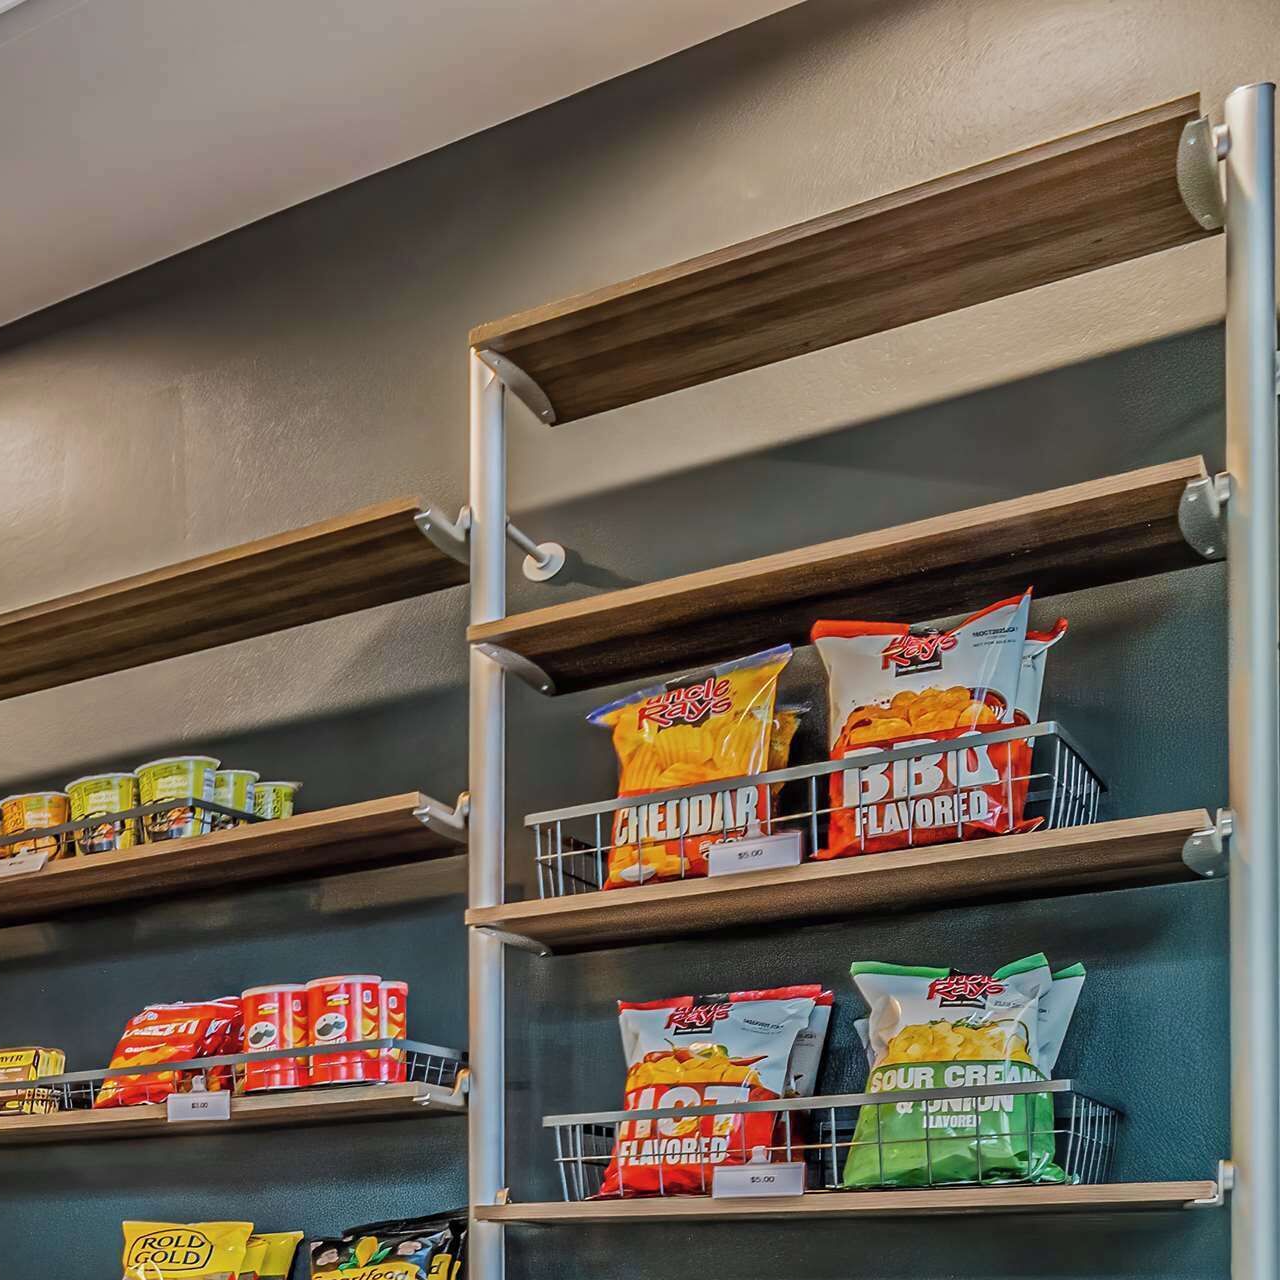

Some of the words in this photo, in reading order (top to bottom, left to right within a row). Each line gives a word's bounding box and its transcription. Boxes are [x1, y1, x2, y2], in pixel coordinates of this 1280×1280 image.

[843, 731, 1000, 808] BBQ
[615, 786, 759, 842] CHEDDAR
[855, 790, 988, 838] FLAVORED
[738, 848, 764, 860] $5.00
[870, 1066, 935, 1094] SOUR
[620, 1136, 729, 1167] FLAVORED
[751, 1175, 775, 1184] $5.00
[139, 1234, 206, 1250] ROLD
[134, 1251, 201, 1266] GOLD
